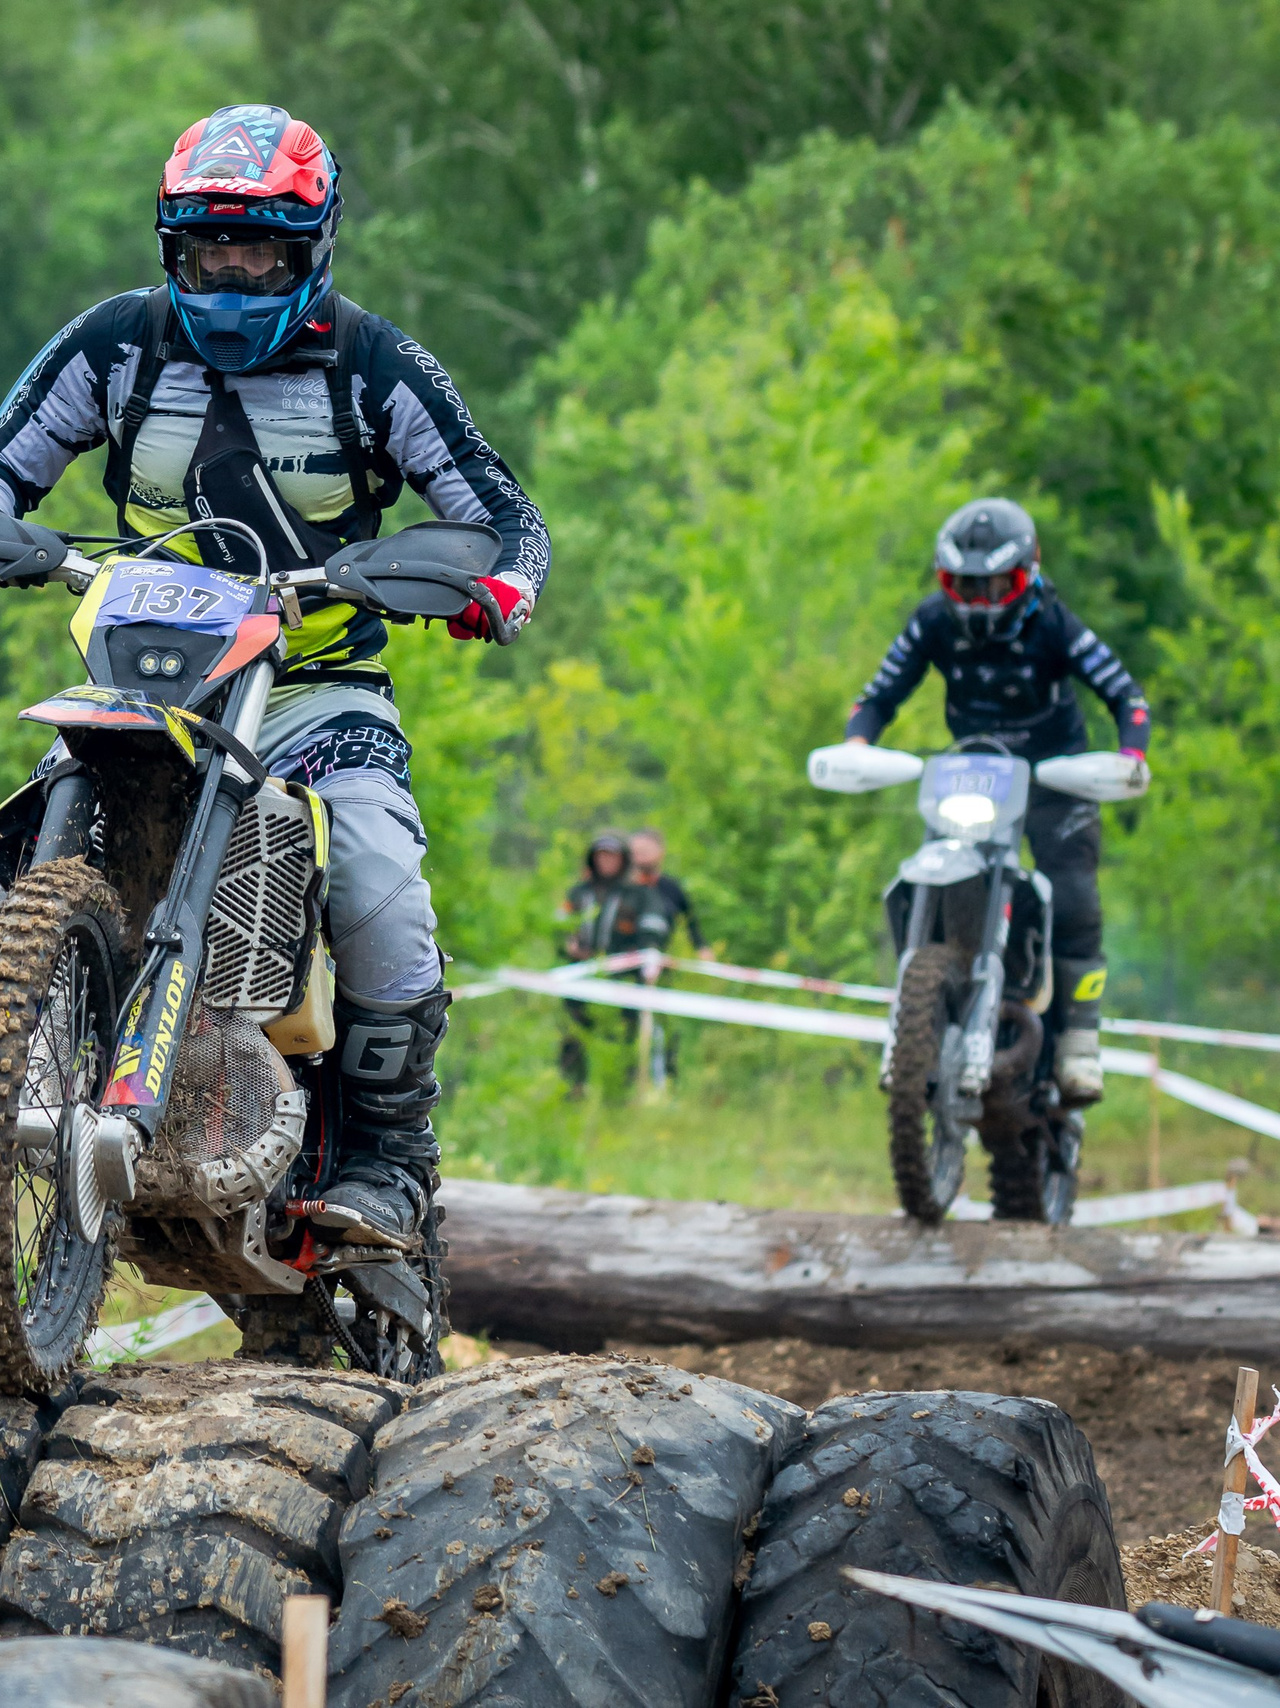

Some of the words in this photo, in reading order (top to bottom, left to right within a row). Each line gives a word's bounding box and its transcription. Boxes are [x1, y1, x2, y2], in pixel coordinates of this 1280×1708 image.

[282, 398, 328, 410] RACI
[210, 573, 253, 595] СЕРЕБРО
[127, 582, 224, 620] 137
[145, 961, 186, 1099] DUNLOP
